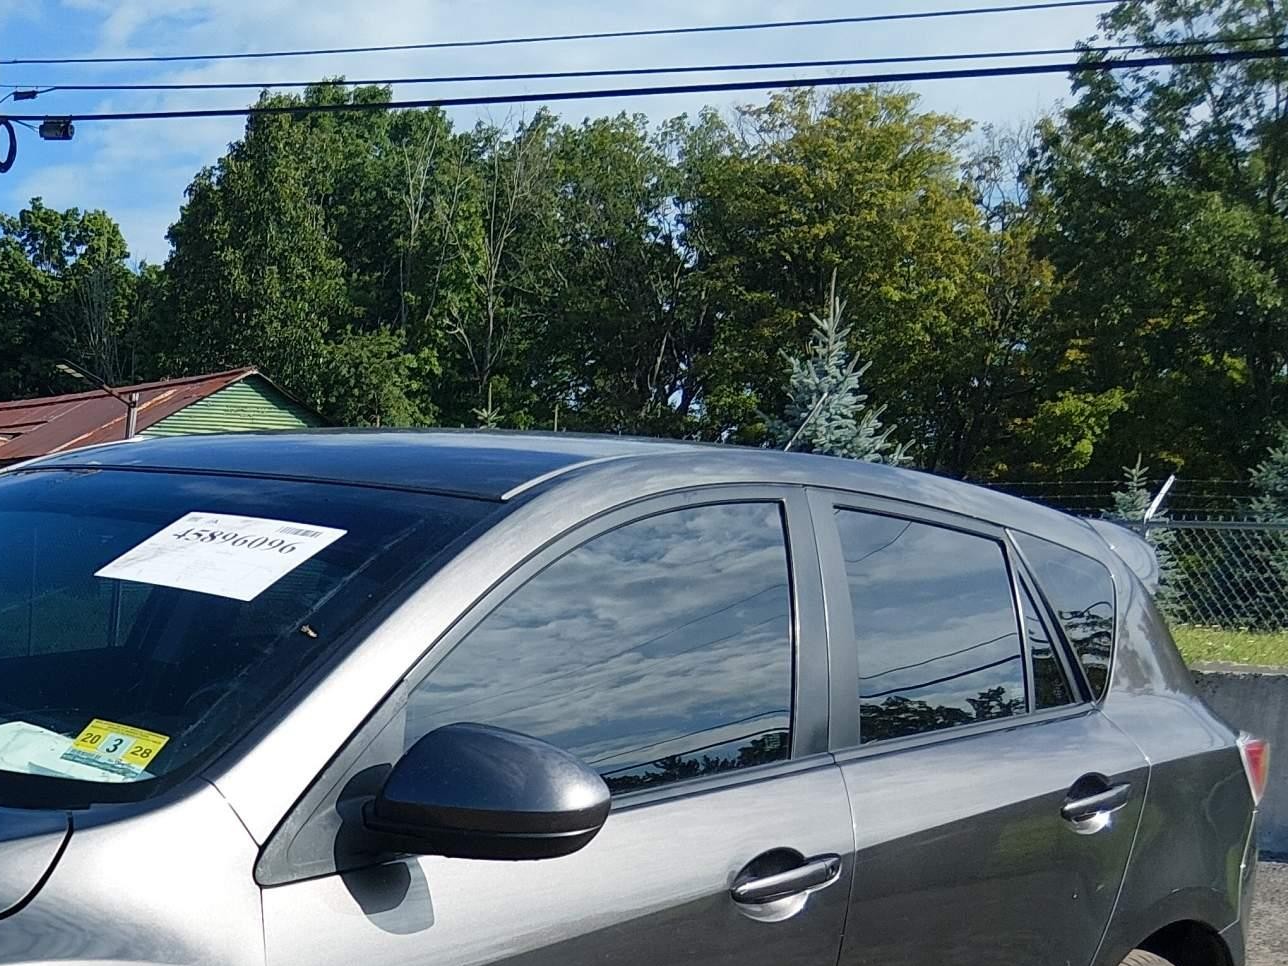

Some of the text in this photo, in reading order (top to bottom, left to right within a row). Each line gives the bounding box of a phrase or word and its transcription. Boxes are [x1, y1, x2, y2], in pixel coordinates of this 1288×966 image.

[172, 527, 301, 555] 45896096
[80, 732, 101, 745] 20
[105, 738, 124, 753] 3
[130, 745, 153, 759] 28
